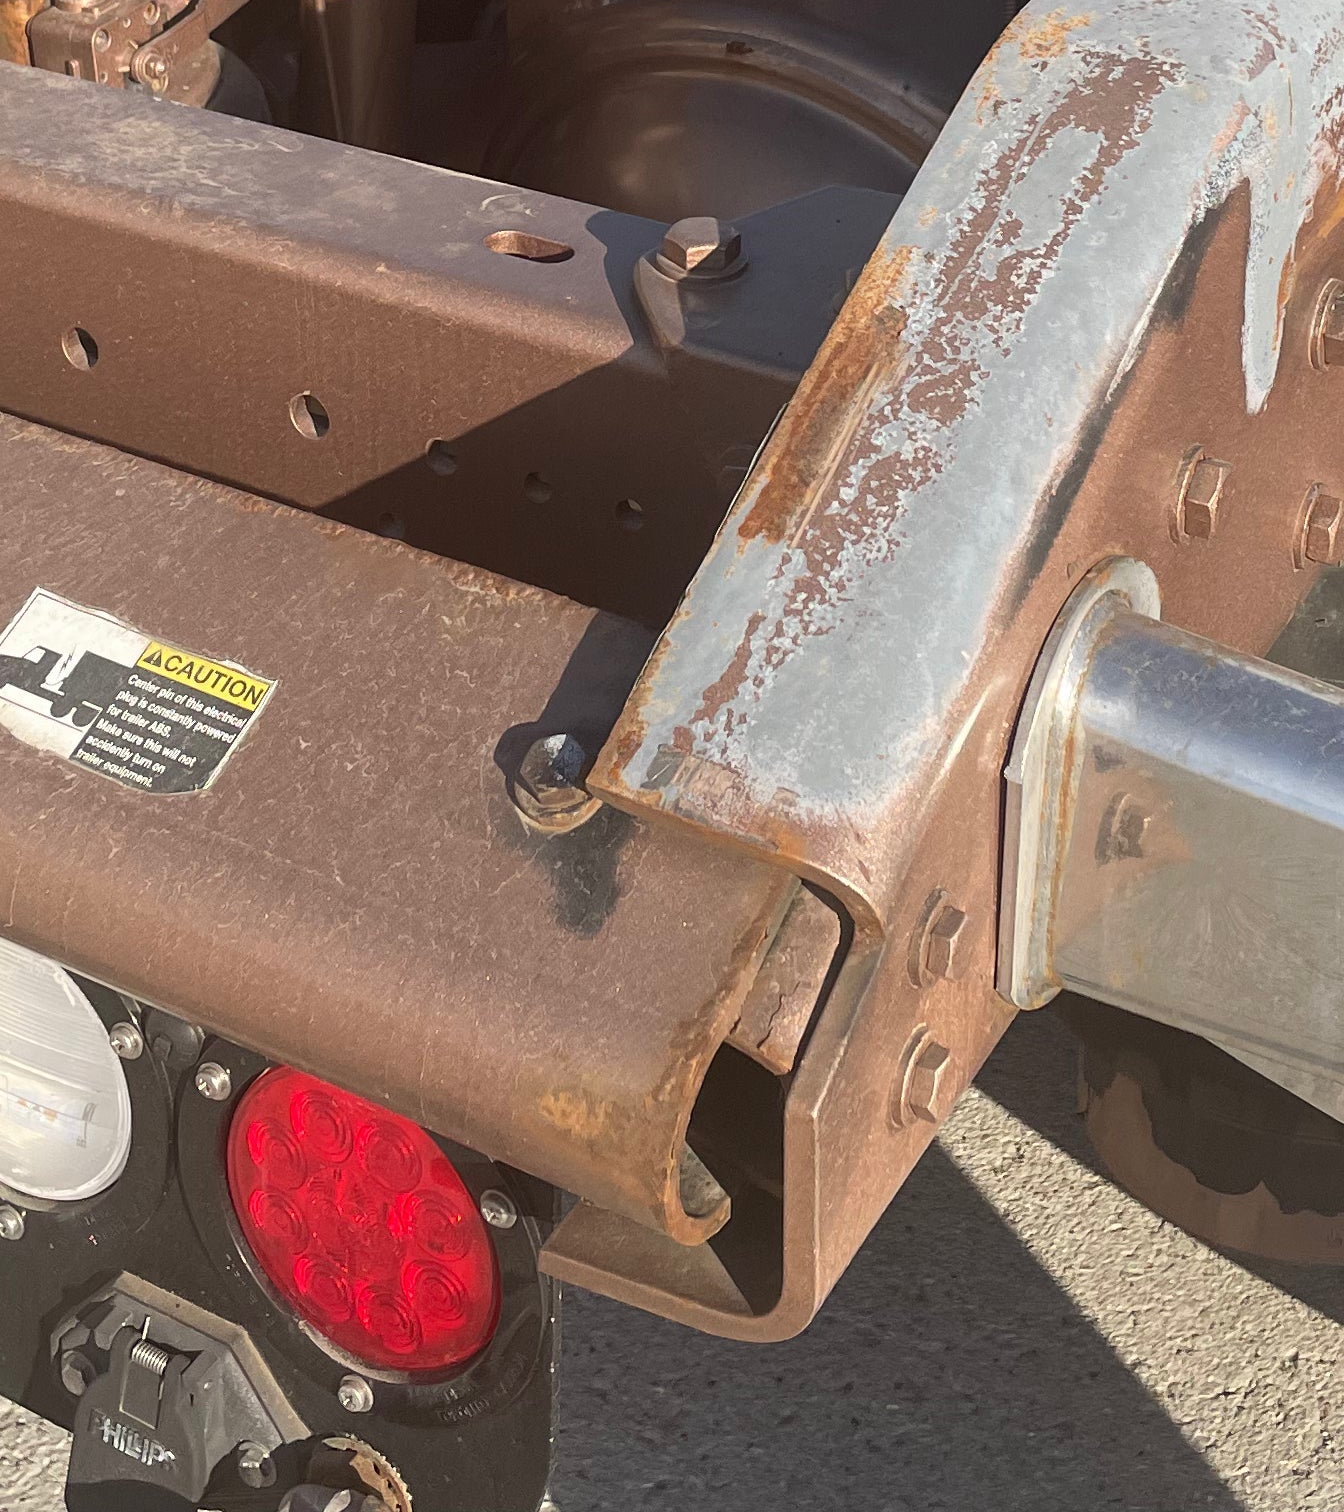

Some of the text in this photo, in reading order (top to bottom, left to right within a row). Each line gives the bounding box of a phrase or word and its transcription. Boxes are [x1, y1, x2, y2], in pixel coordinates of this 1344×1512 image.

[127, 674, 248, 729] Center pin of this electrical
[163, 654, 265, 706] CAUTION
[106, 703, 172, 739] for trailer ABS.
[115, 690, 237, 744] plug is constantly powered
[76, 748, 154, 788] trailer equipment.
[85, 735, 167, 775] accidently turn on
[95, 718, 197, 768] Make sure this will not
